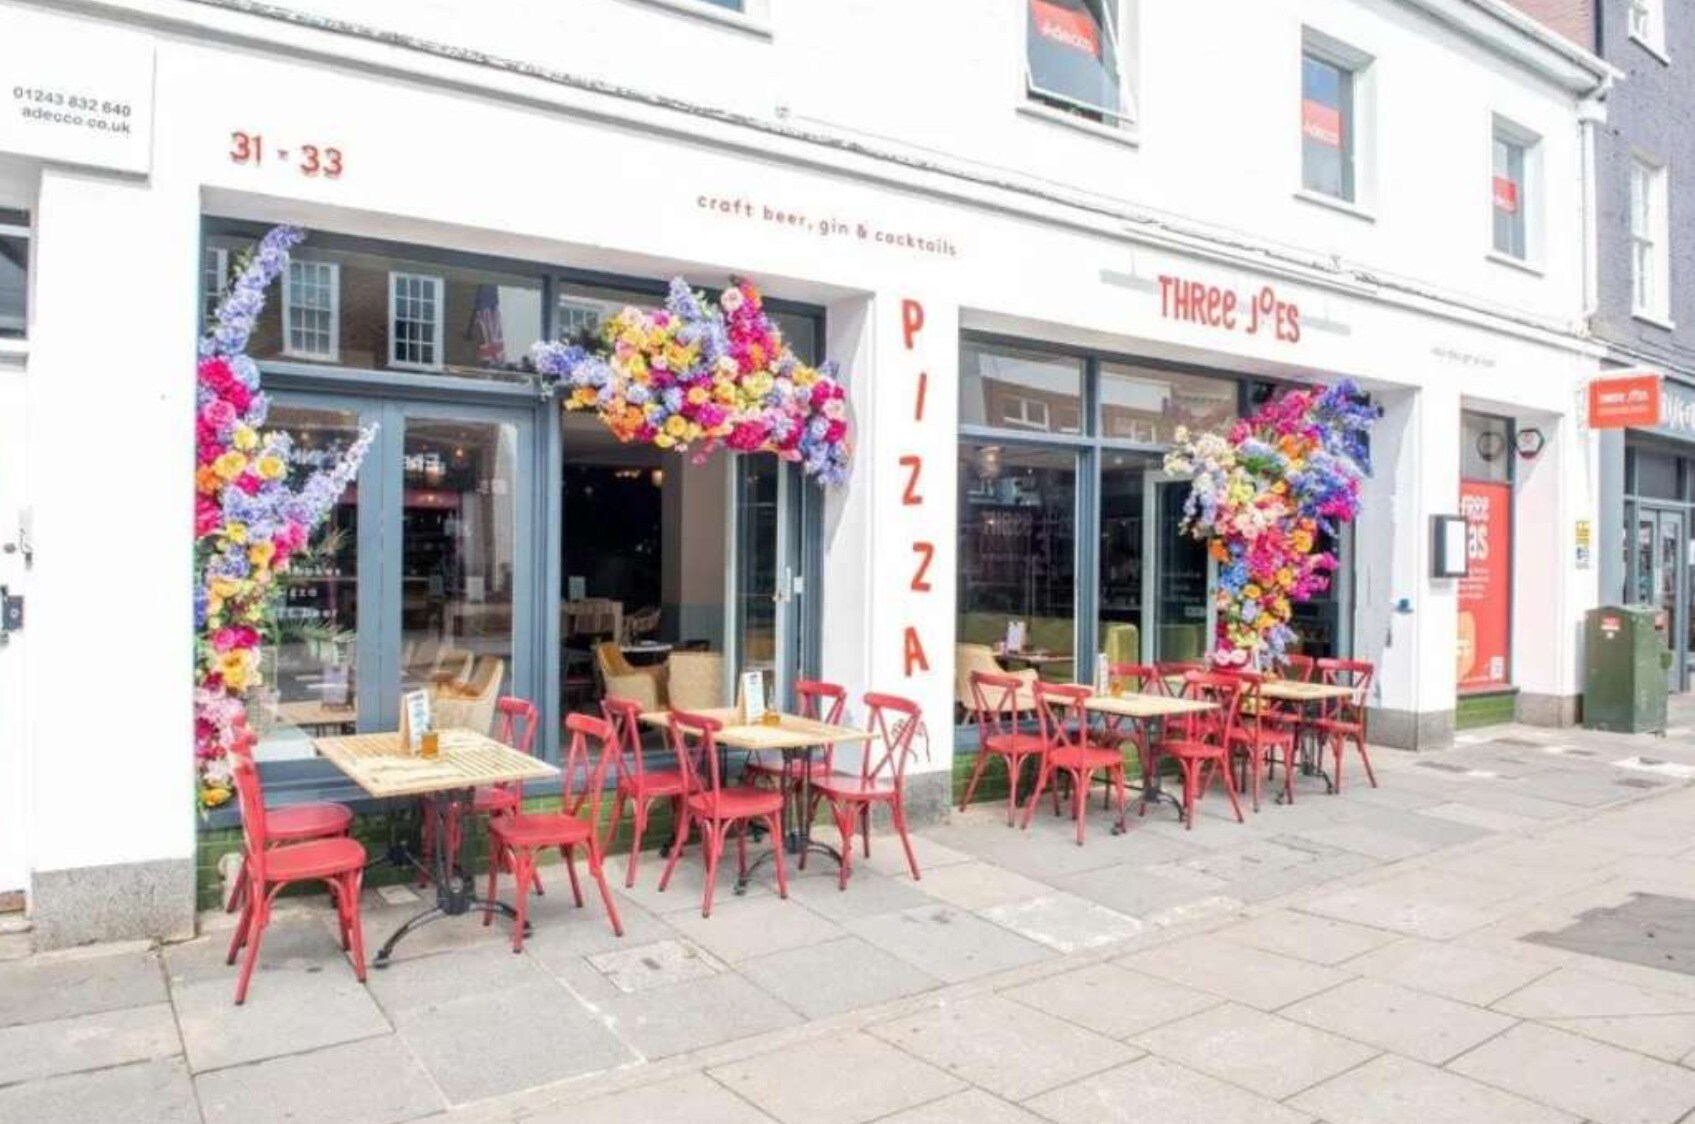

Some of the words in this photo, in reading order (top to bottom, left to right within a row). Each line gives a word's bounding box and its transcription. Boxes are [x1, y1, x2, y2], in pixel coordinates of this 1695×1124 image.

[13, 86, 64, 106] 01243
[68, 95, 98, 112] 832
[230, 131, 261, 165] 31
[300, 144, 343, 178] 33
[697, 195, 756, 217] craft
[763, 205, 814, 231] beer,
[820, 218, 848, 236] gin
[856, 223, 867, 239] &
[875, 231, 957, 256] cocktails
[899, 298, 935, 677] PIZZA
